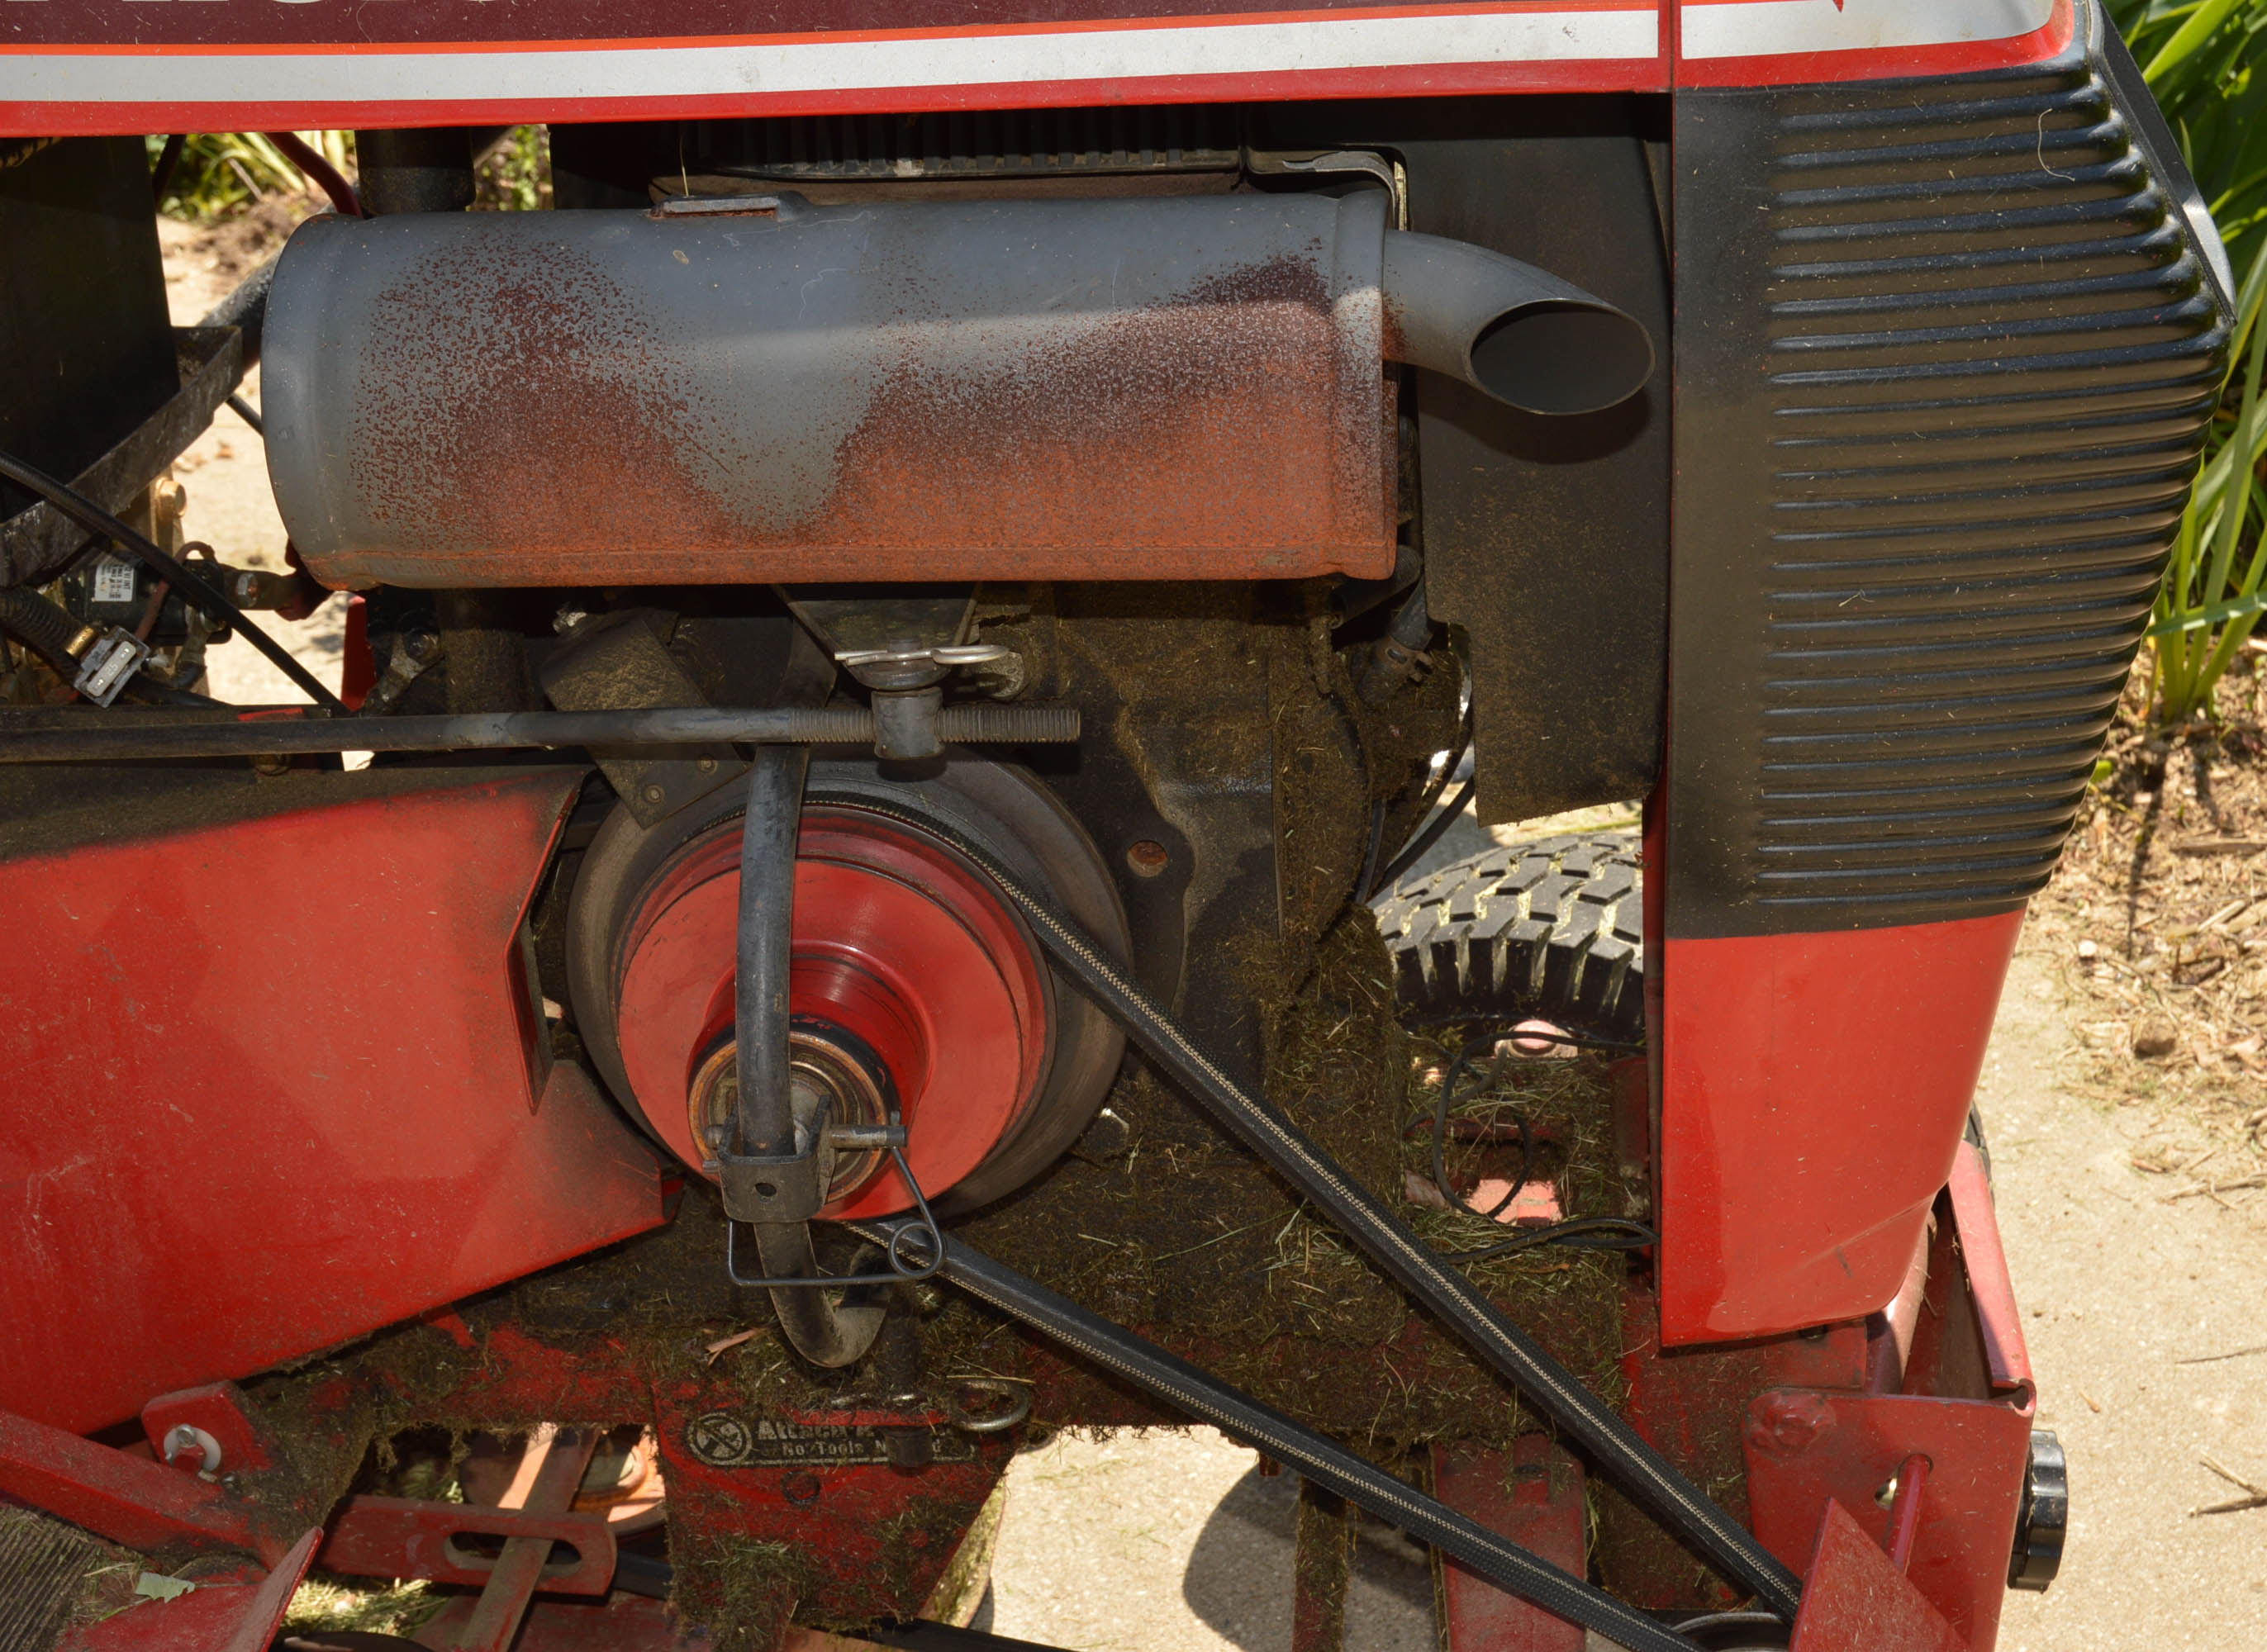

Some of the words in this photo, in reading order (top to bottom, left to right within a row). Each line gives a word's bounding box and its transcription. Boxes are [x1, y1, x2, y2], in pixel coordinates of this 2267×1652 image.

[106, 662, 118, 676] 25
[782, 1441, 806, 1455] No
[815, 1441, 865, 1455] Tools
